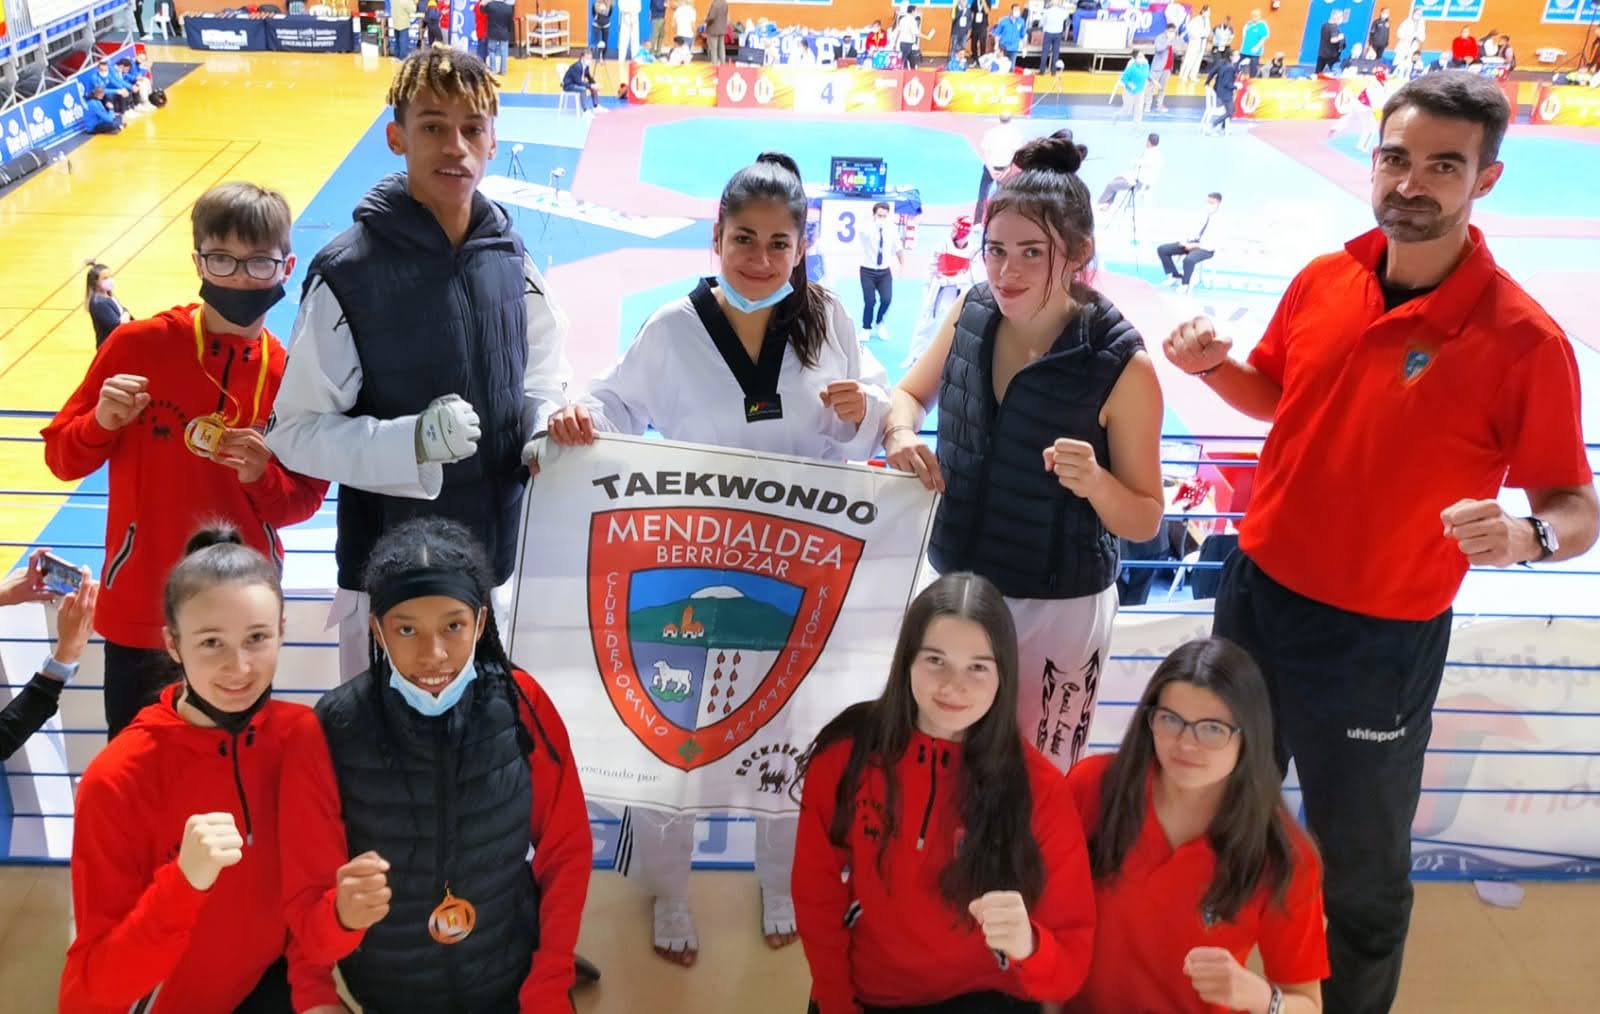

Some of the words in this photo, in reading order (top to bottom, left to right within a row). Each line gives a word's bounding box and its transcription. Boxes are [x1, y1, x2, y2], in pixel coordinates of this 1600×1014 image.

[821, 81, 835, 105] 4
[836, 211, 856, 243] 3
[592, 470, 878, 525] TAEKWONDO
[607, 514, 843, 570] MENDIALDEA
[656, 544, 790, 577] BERRIOZAR
[604, 572, 619, 626] CLUB
[800, 585, 830, 649] KIROL
[604, 634, 669, 737] DEPORTIVO
[1346, 727, 1408, 743] uhlsport
